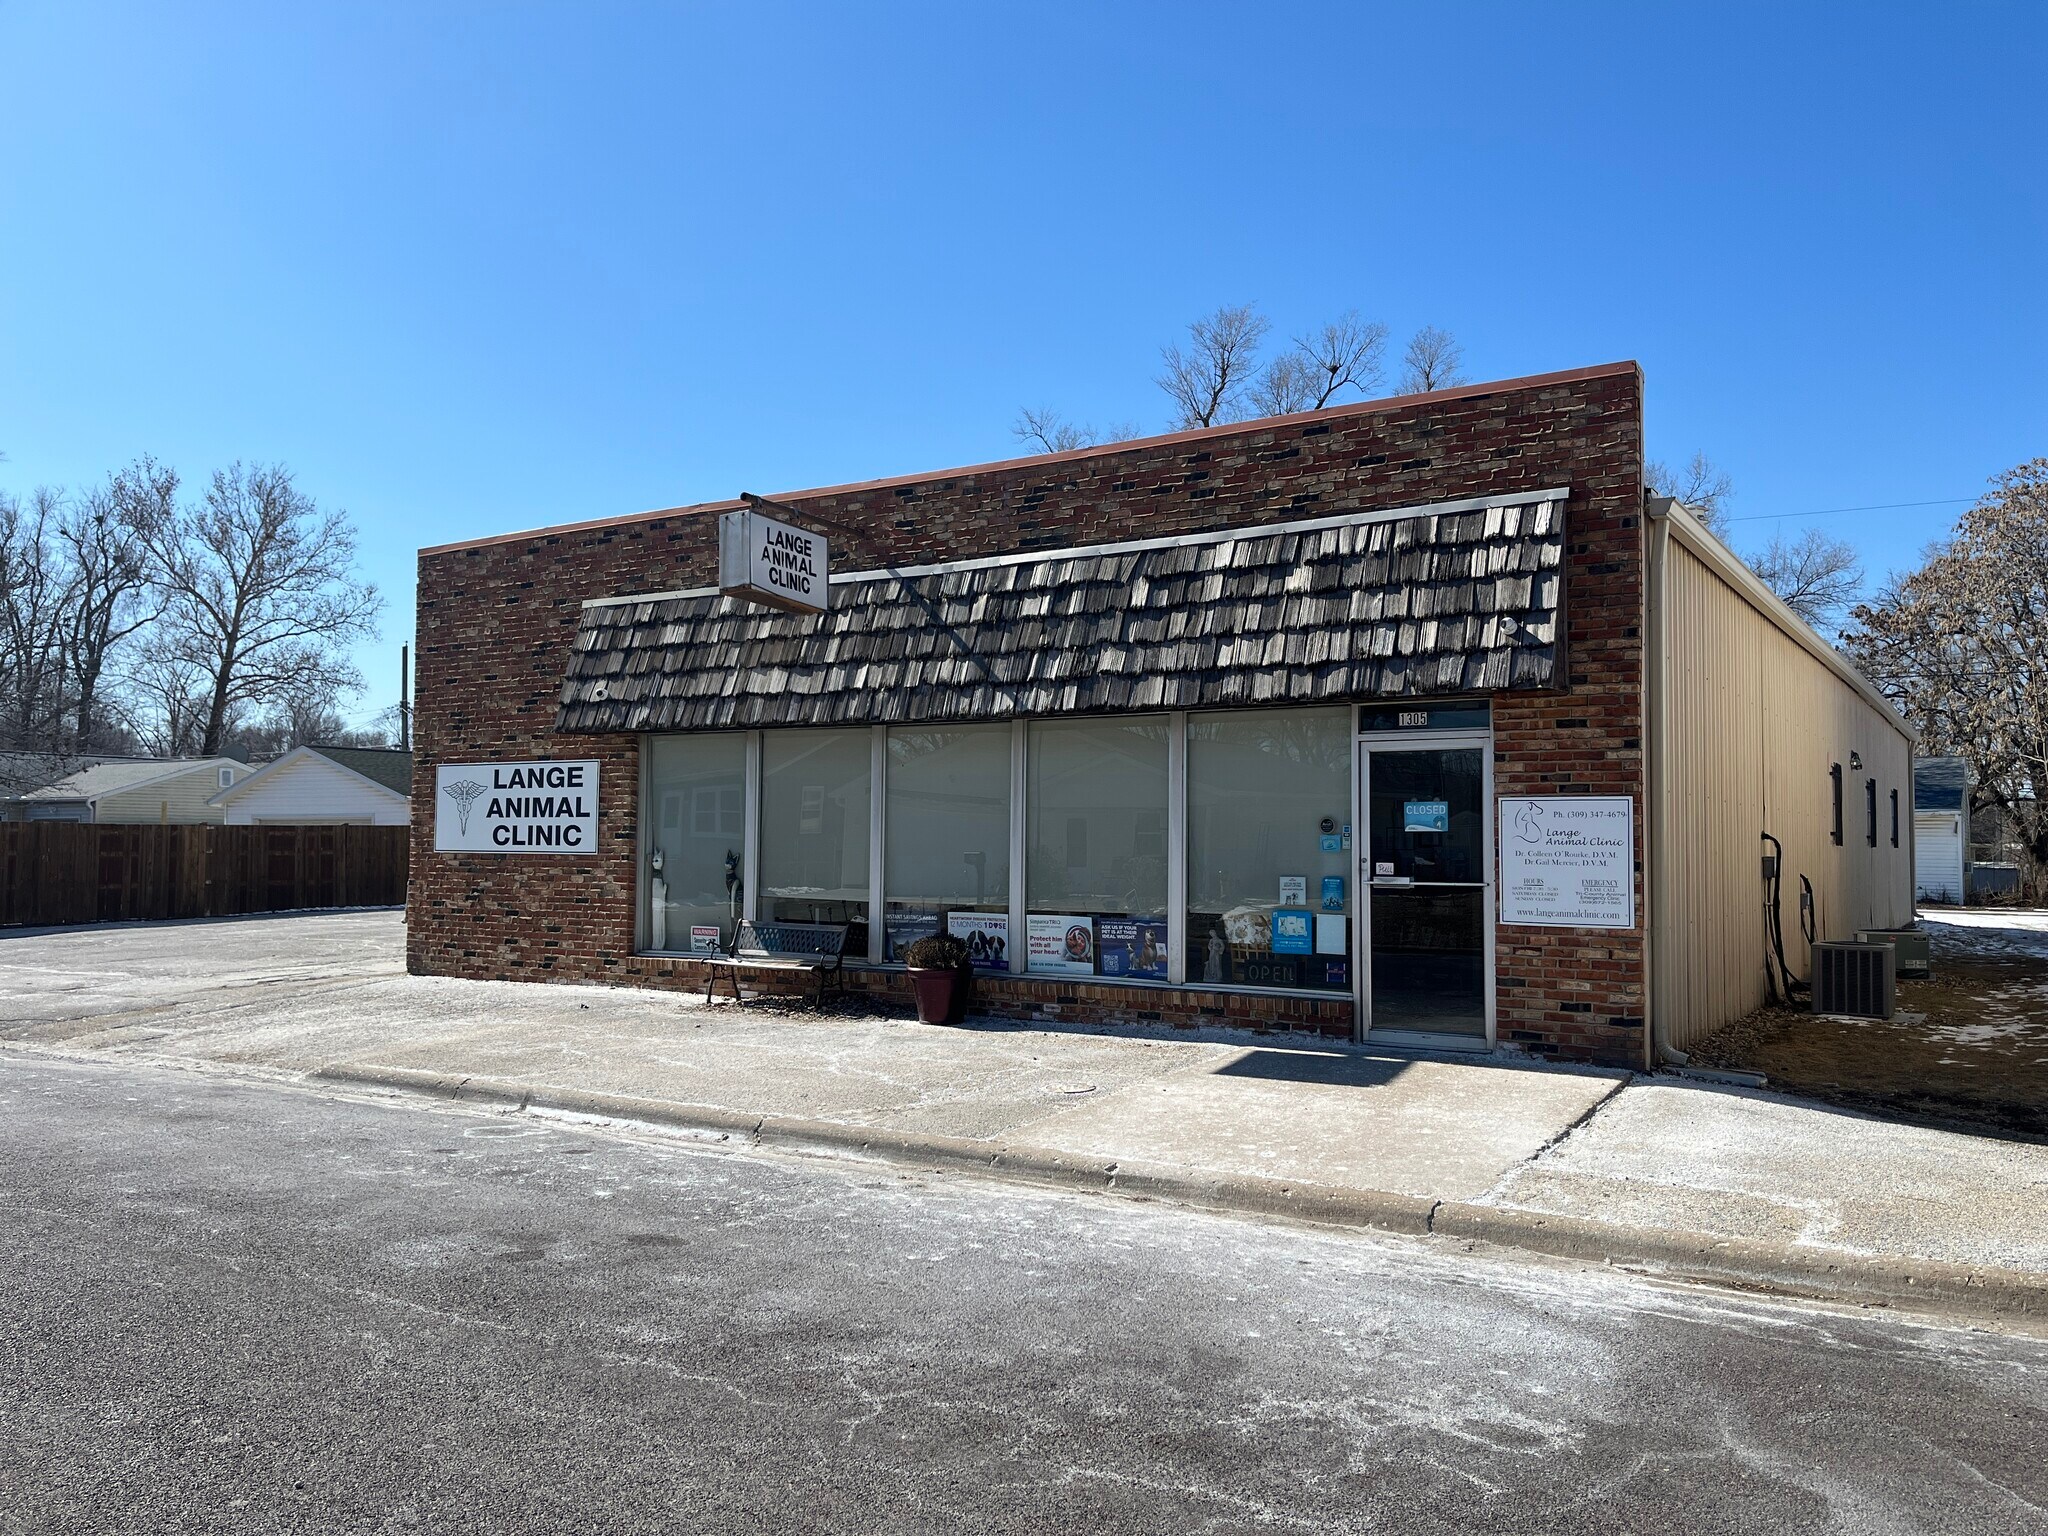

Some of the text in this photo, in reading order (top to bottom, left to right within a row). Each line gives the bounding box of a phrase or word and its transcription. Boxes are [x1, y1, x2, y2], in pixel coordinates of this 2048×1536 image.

[767, 526, 812, 558] LANGE
[761, 545, 817, 578] ANIMAL
[769, 566, 811, 595] CLINIC
[1399, 711, 1427, 726] 1305
[493, 766, 584, 789] LANGE
[486, 796, 591, 818] ANIMAL
[1406, 805, 1446, 815] CLOSED
[1553, 810, 1626, 819] Ph. (309) 347-4679
[492, 824, 582, 847] CLINIC
[1546, 828, 1582, 839] Lange
[1545, 837, 1625, 847] Animal Clinic
[1592, 851, 1619, 859] D.V.M.
[1516, 908, 1620, 919] www.langeanimalclinic.com
[957, 921, 983, 929] MONTHS
[693, 928, 717, 936] WARNING
[1249, 965, 1294, 982] OPEN
